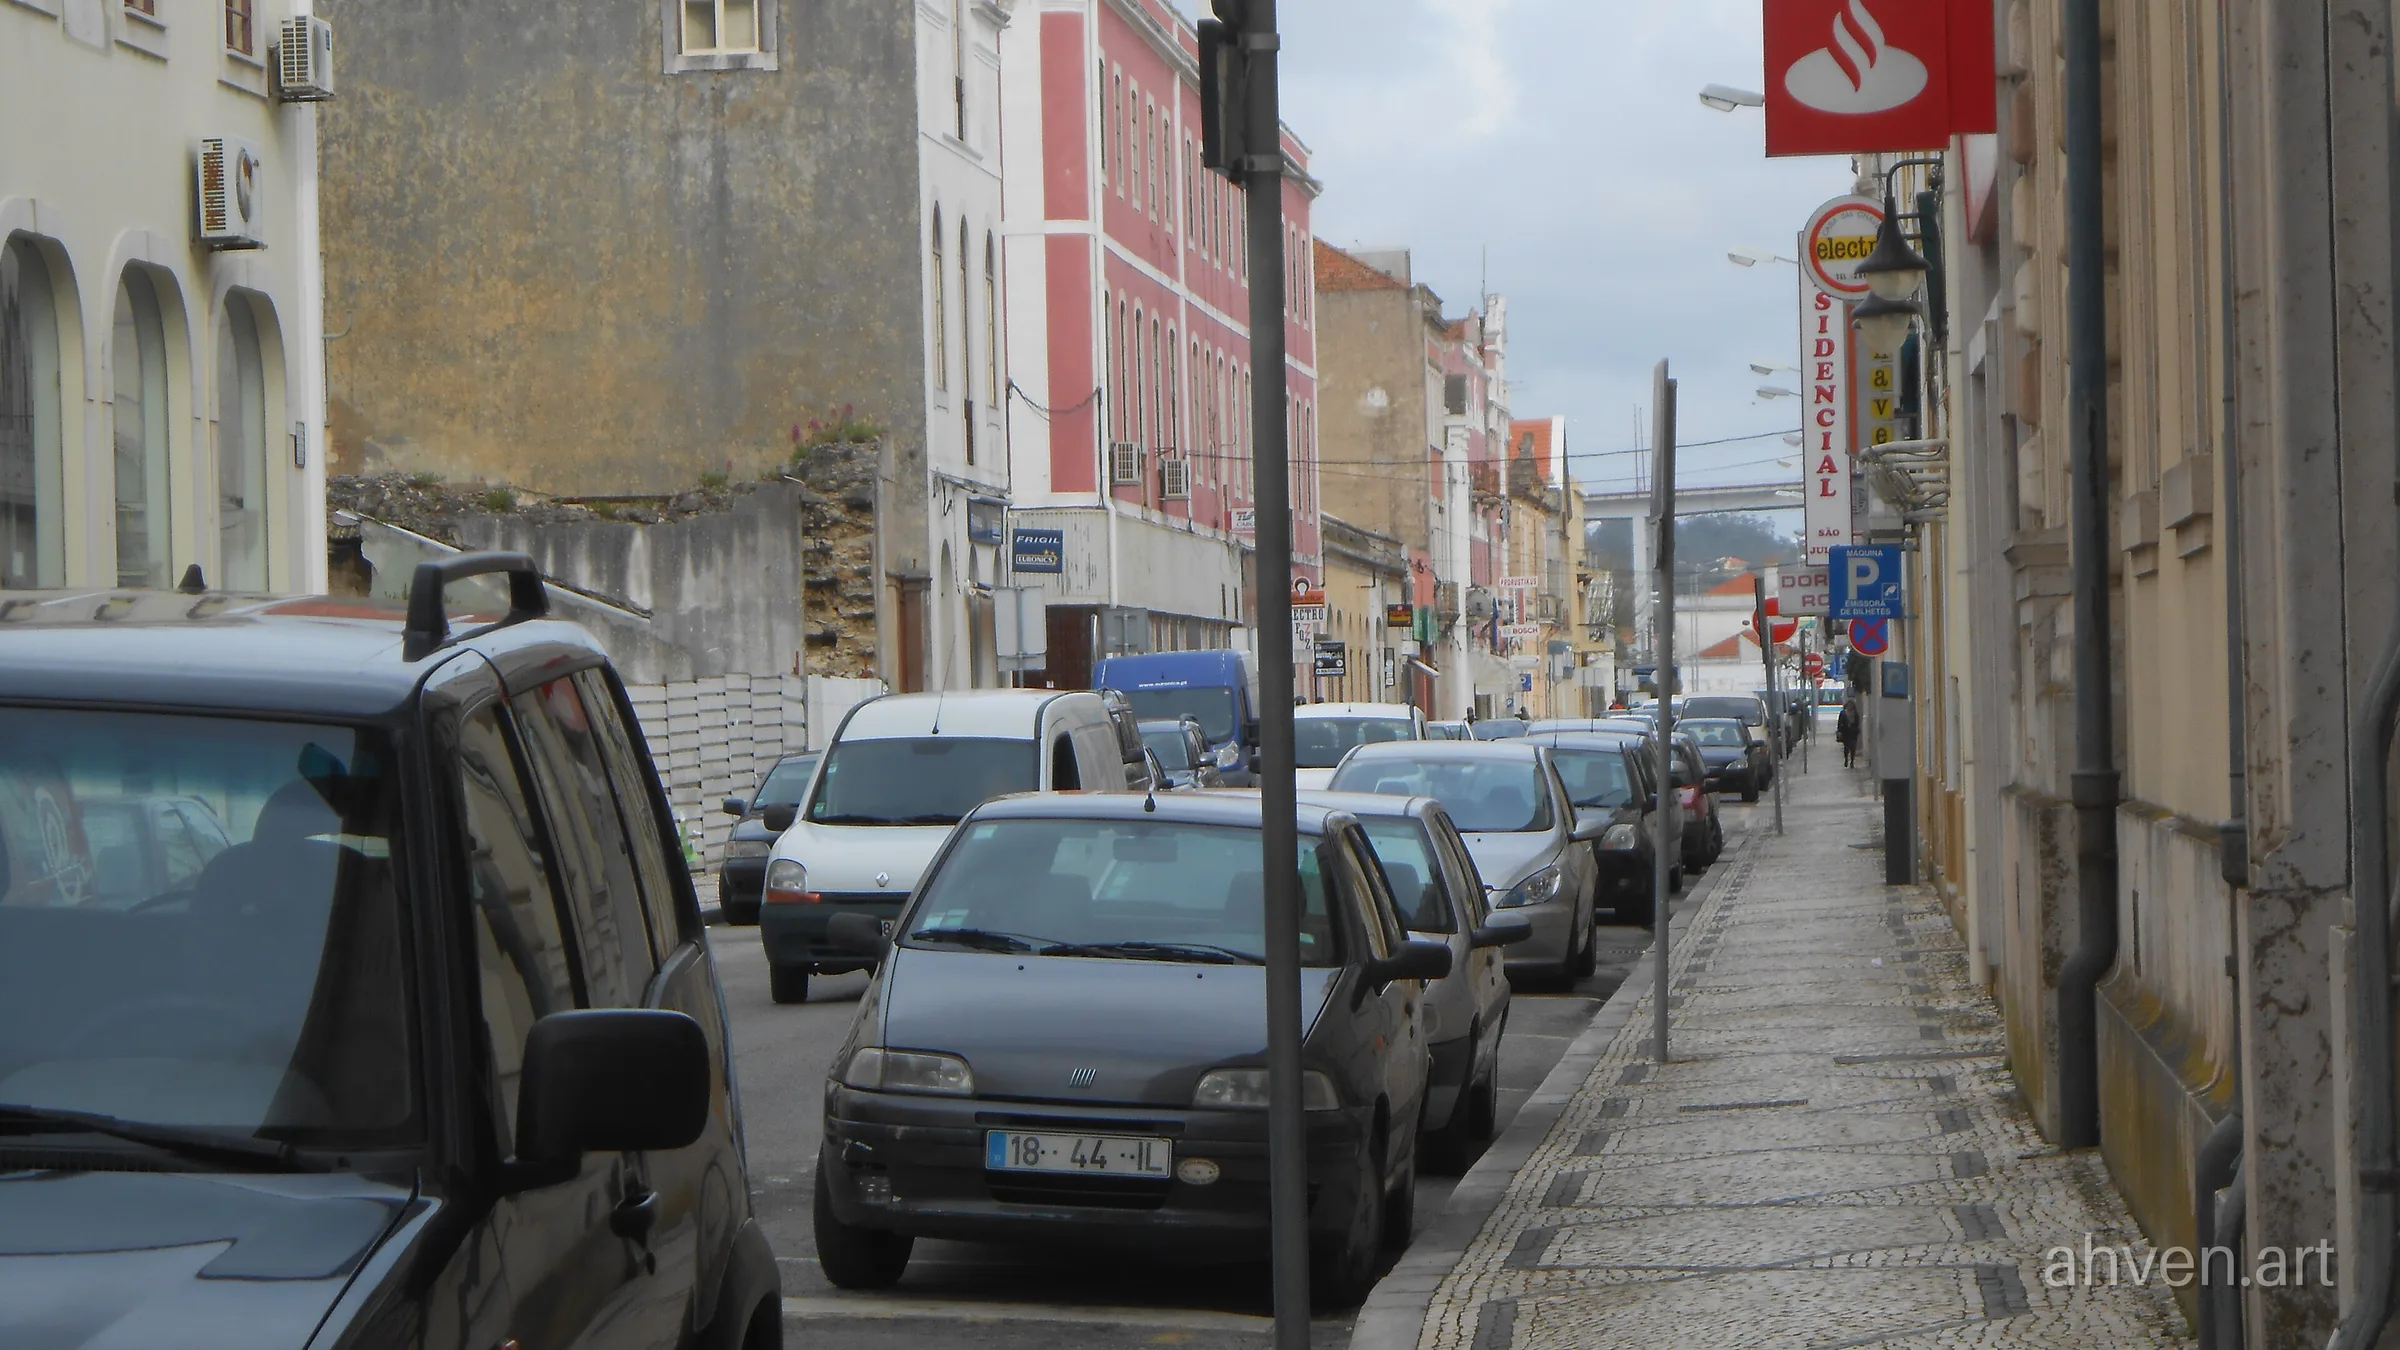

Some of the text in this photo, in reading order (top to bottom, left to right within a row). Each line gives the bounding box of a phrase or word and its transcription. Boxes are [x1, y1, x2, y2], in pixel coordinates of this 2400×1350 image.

[1873, 352, 1890, 444] ave
[1818, 527, 1840, 537] SÃO
[1016, 535, 1060, 544] FRIGIL
[1846, 548, 1884, 557] MÁQUINA
[1848, 557, 1880, 600] P
[1840, 607, 1891, 616] DE BILHETES
[1512, 627, 1538, 635] BOSCH
[1011, 1136, 1040, 1166] 18
[1070, 1138, 1107, 1169] 44
